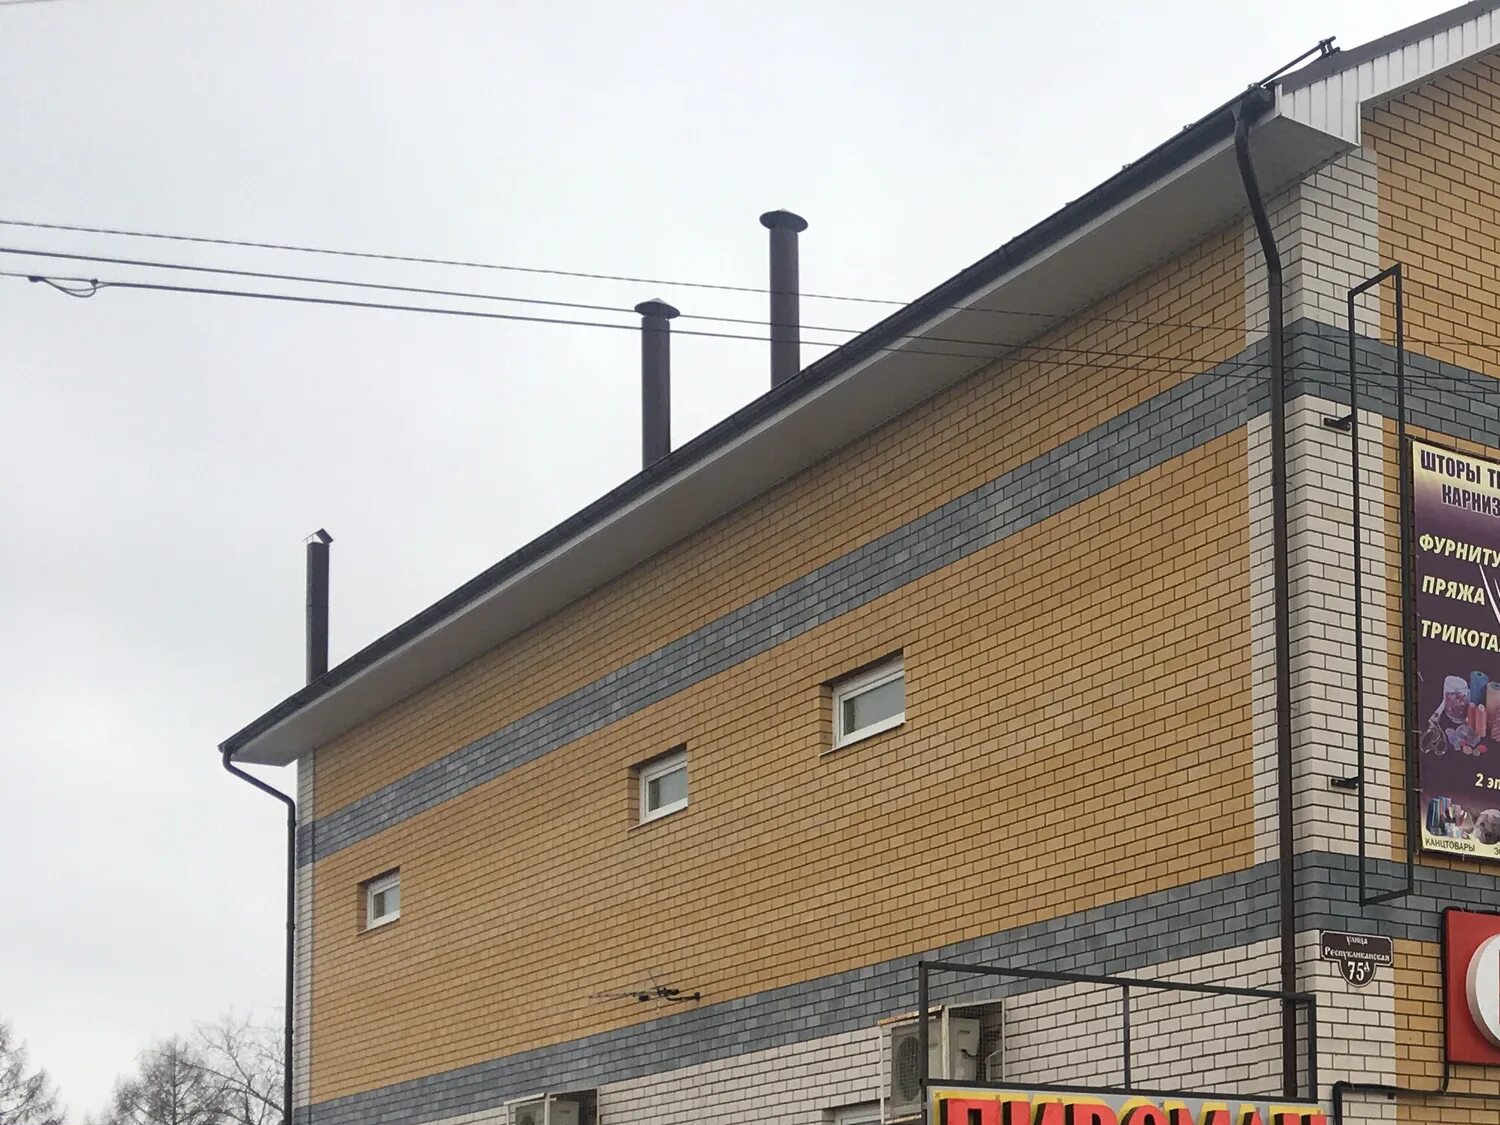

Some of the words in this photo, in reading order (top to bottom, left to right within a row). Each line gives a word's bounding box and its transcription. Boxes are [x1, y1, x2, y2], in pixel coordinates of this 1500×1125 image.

[1420, 449, 1480, 484] ШТОРЫ
[1422, 575, 1486, 606] ПРЯЖА
[1475, 773, 1484, 788] 2
[1425, 838, 1476, 852] КАНЦТОВАРЫ
